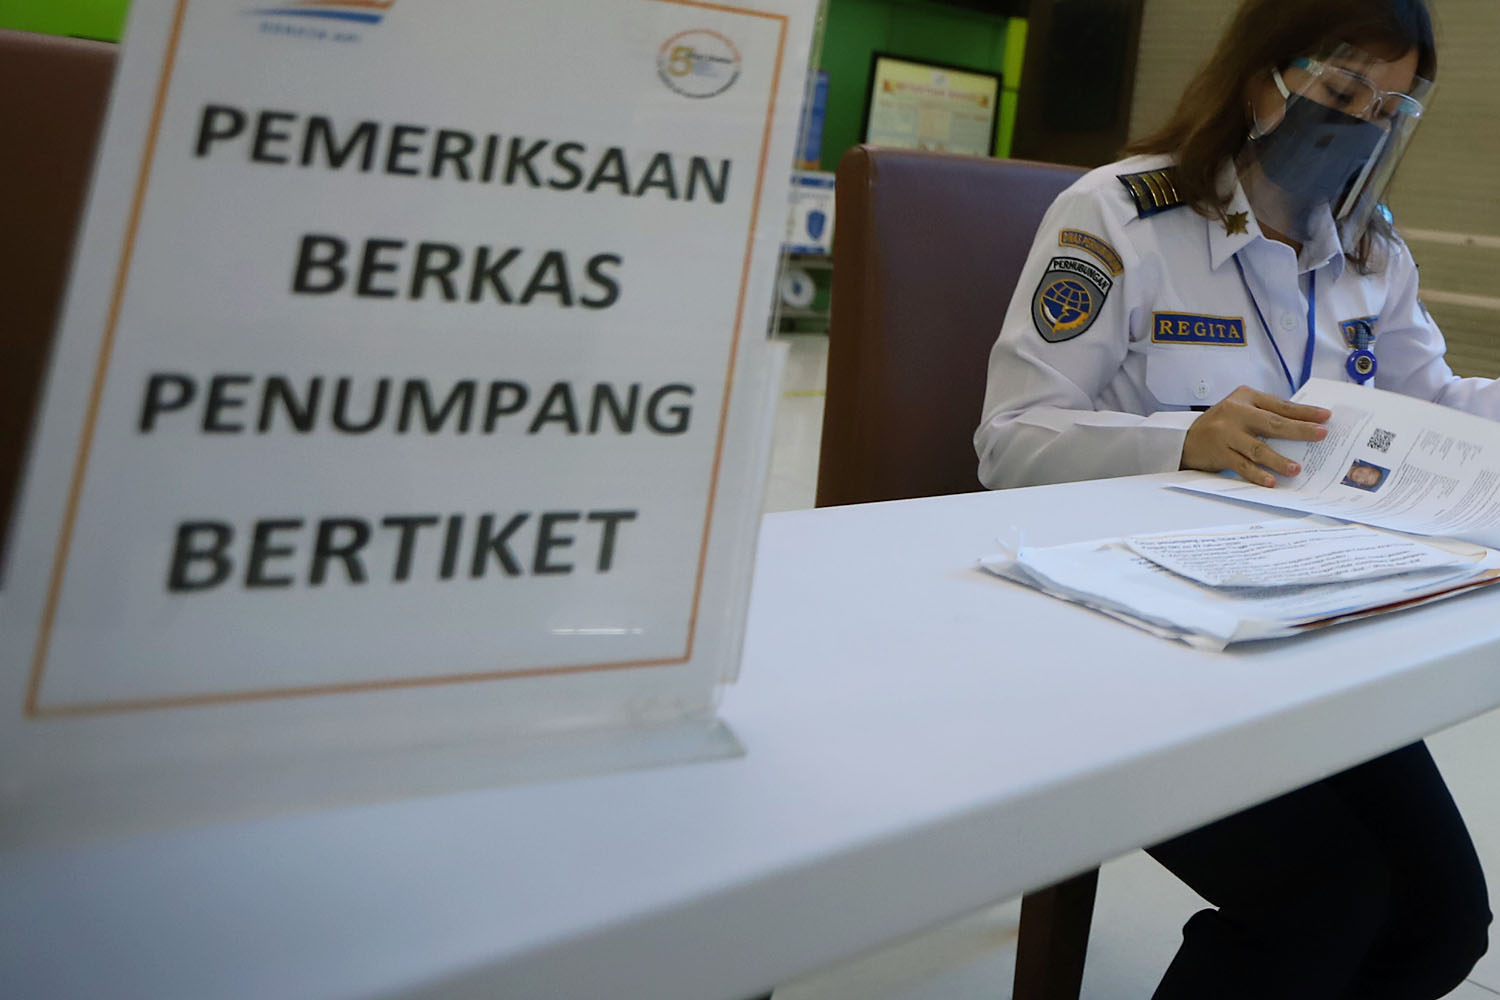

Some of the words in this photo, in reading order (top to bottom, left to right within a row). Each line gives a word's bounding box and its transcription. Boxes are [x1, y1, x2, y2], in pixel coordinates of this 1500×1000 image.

[195, 103, 733, 204] PEMERIKSAAN
[292, 232, 625, 311] BERKAS
[1053, 259, 1110, 291] PERHUBUNGAN
[1158, 318, 1242, 341] REGITA
[137, 371, 697, 438] PENUMPANG
[166, 509, 637, 596] BERTIKET
